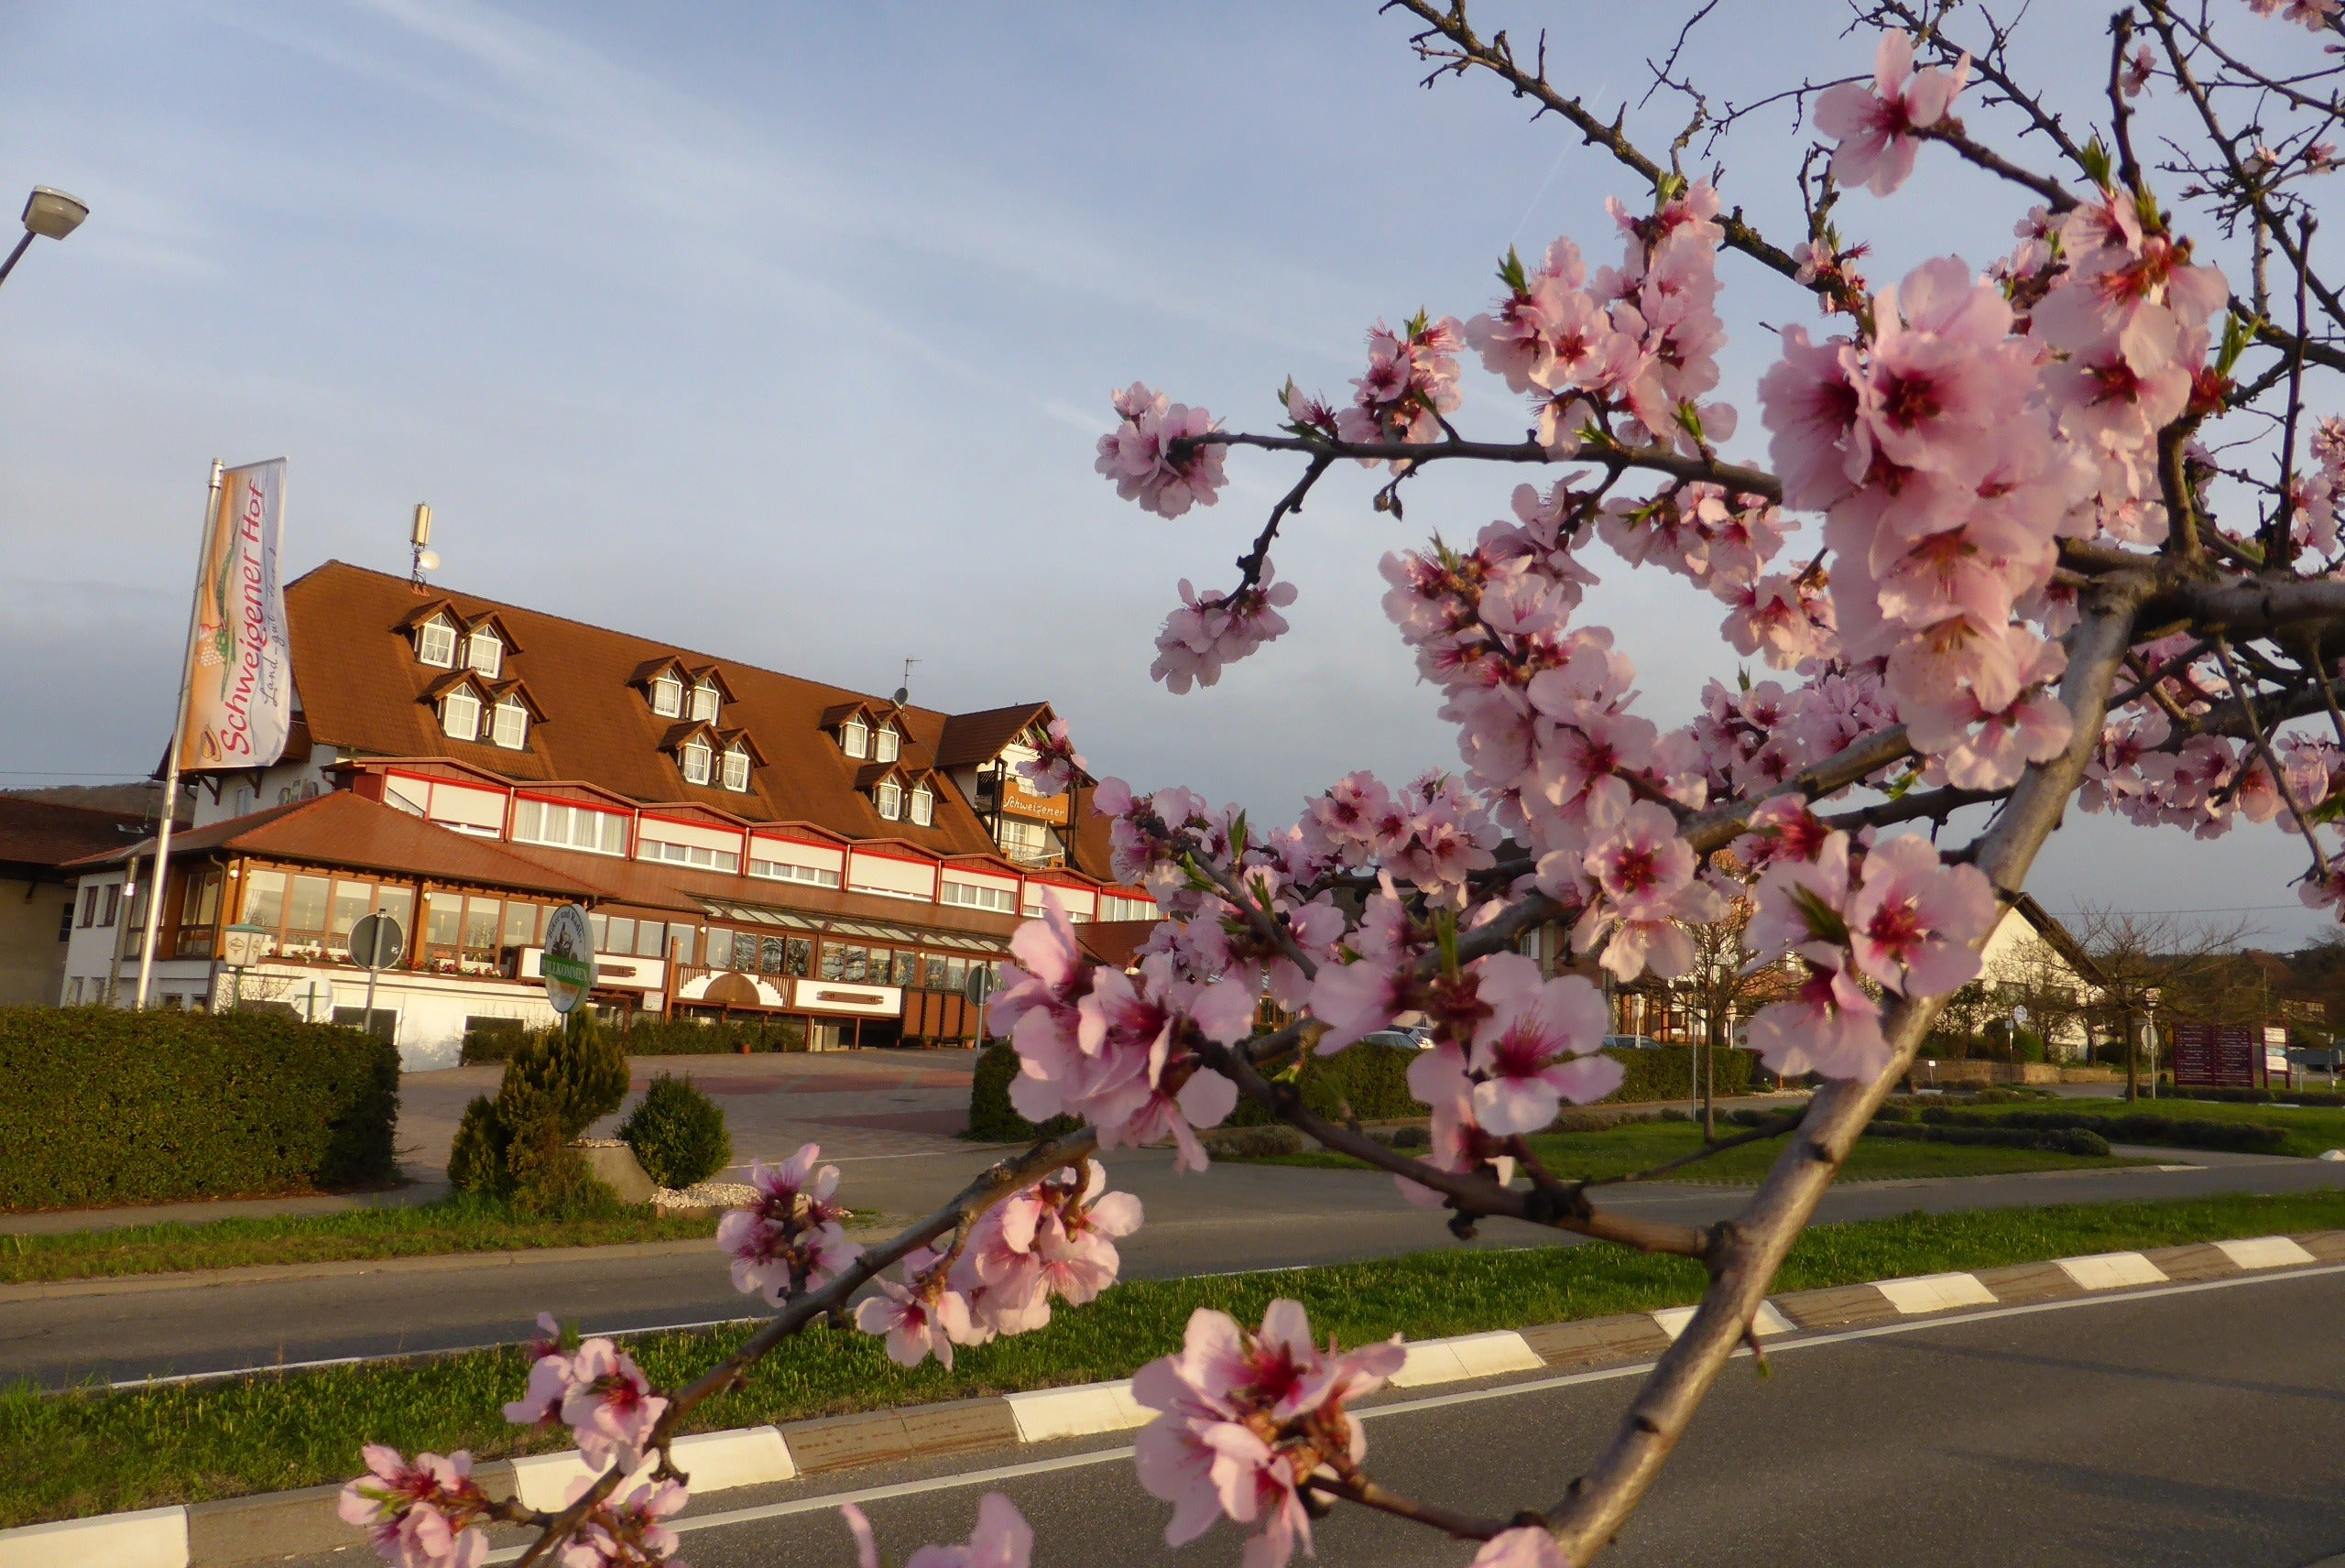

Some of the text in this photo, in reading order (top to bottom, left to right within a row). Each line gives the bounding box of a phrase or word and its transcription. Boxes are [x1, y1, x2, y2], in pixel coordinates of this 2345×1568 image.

[220, 477, 267, 756] Schweigener Hof
[560, 909, 571, 919] und
[540, 958, 587, 983] WILLKOMMEN
